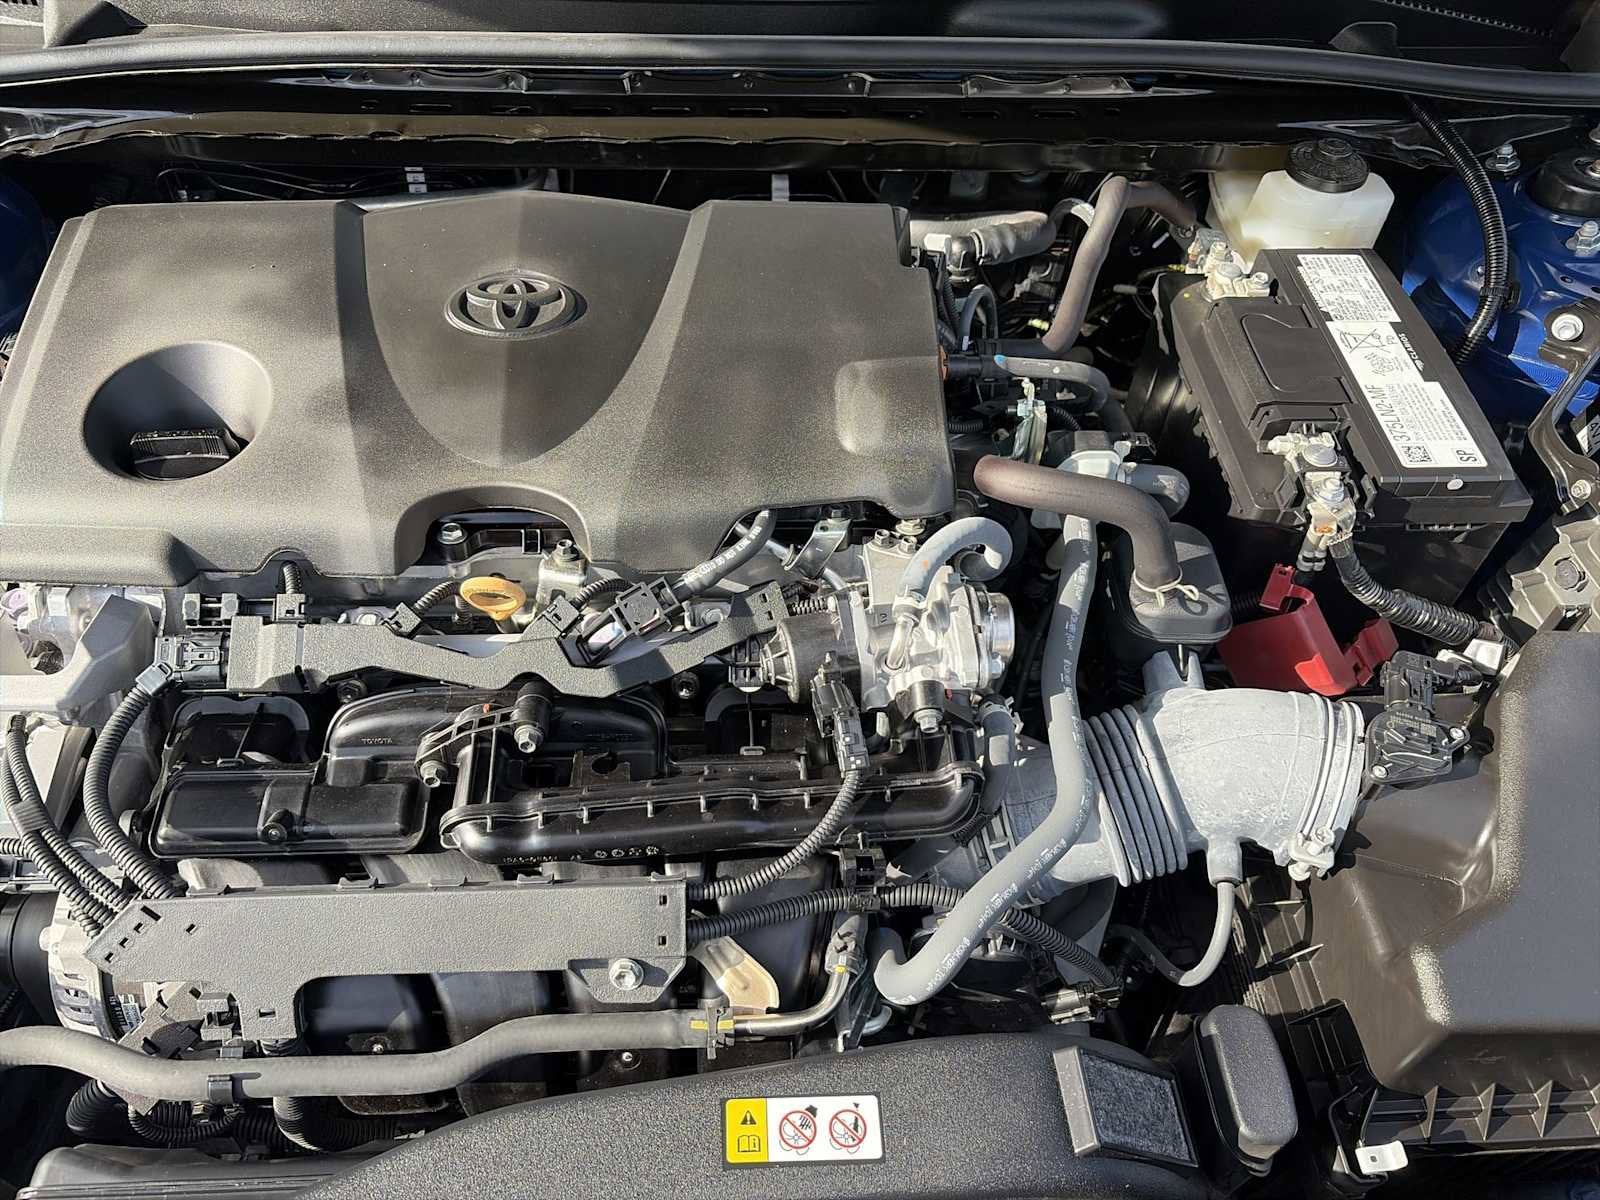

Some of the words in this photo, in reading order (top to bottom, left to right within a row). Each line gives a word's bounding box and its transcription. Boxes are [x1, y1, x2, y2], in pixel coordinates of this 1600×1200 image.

[1399, 333, 1418, 361] CLARIOS
[1365, 384, 1411, 443] 375LN2-MF
[1459, 449, 1477, 463] SP
